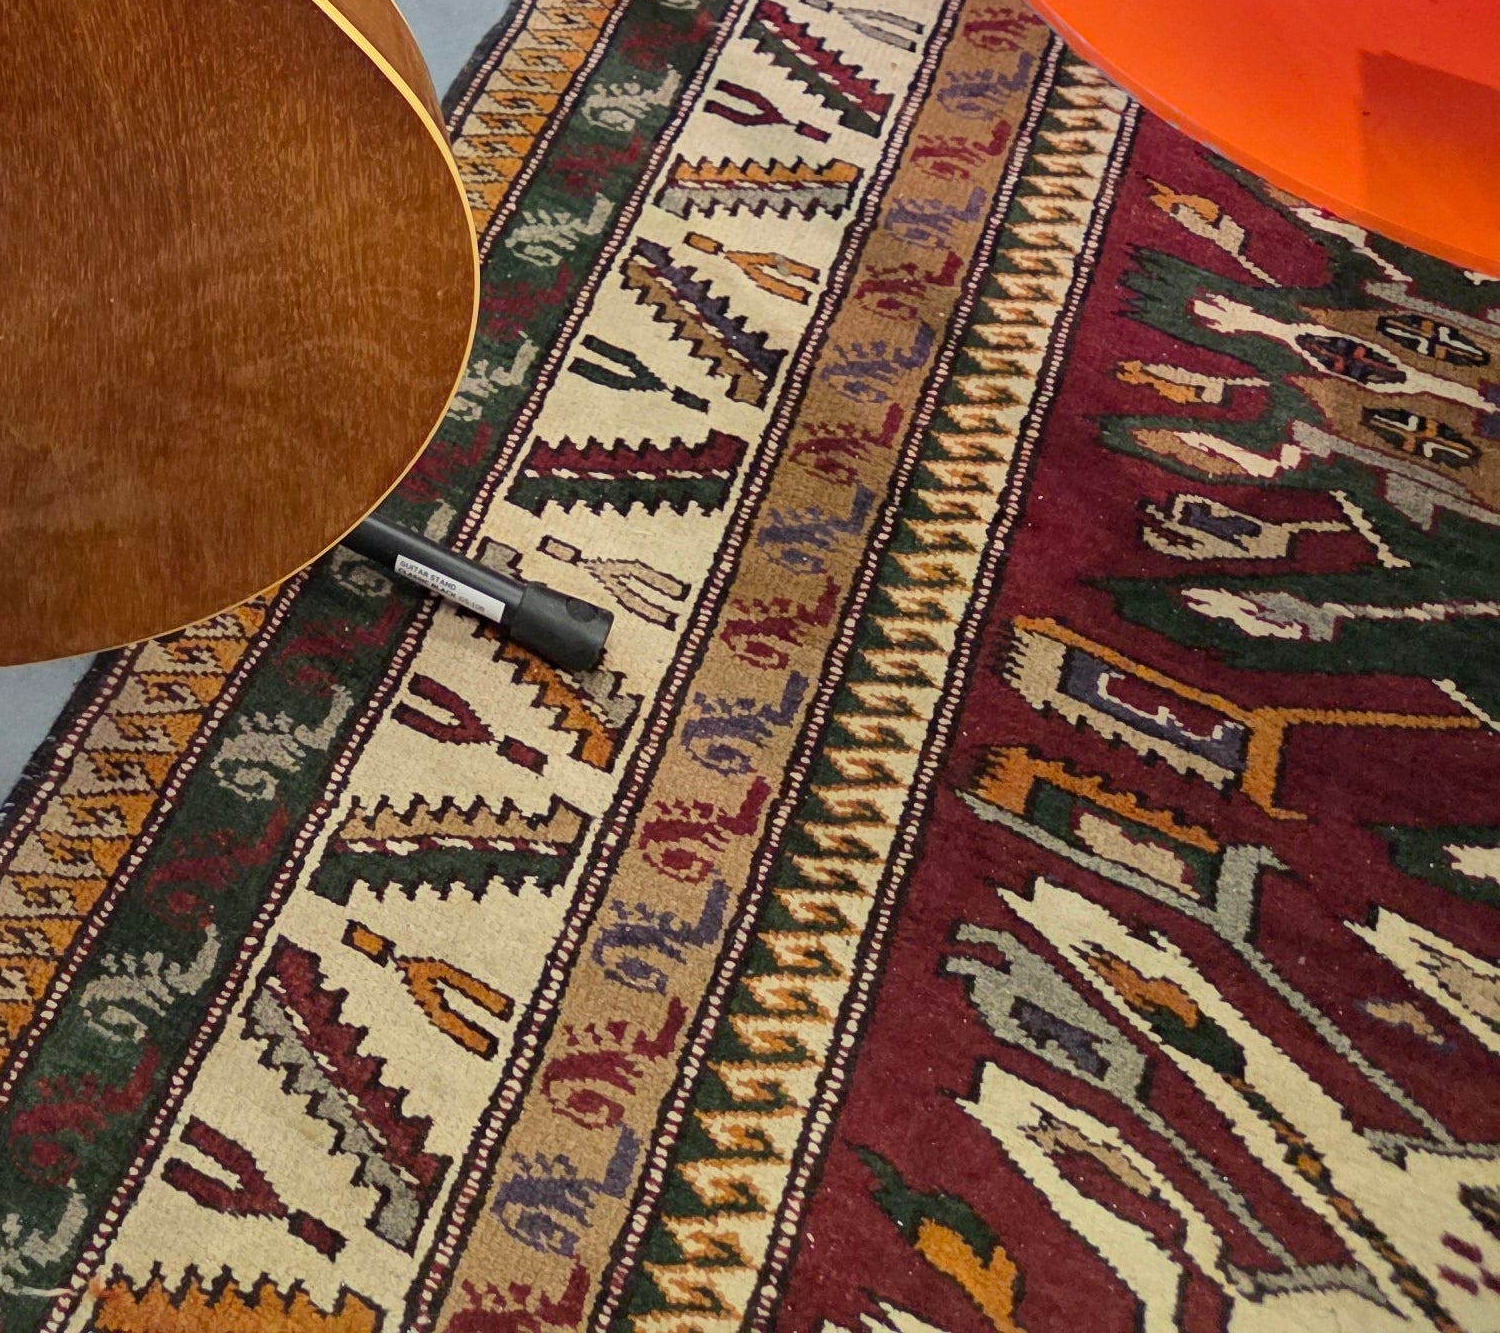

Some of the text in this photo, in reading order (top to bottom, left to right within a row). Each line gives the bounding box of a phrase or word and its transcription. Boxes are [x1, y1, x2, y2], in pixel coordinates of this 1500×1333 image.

[399, 560, 457, 591] GUITAR STAND
[431, 583, 457, 598] BLACK
